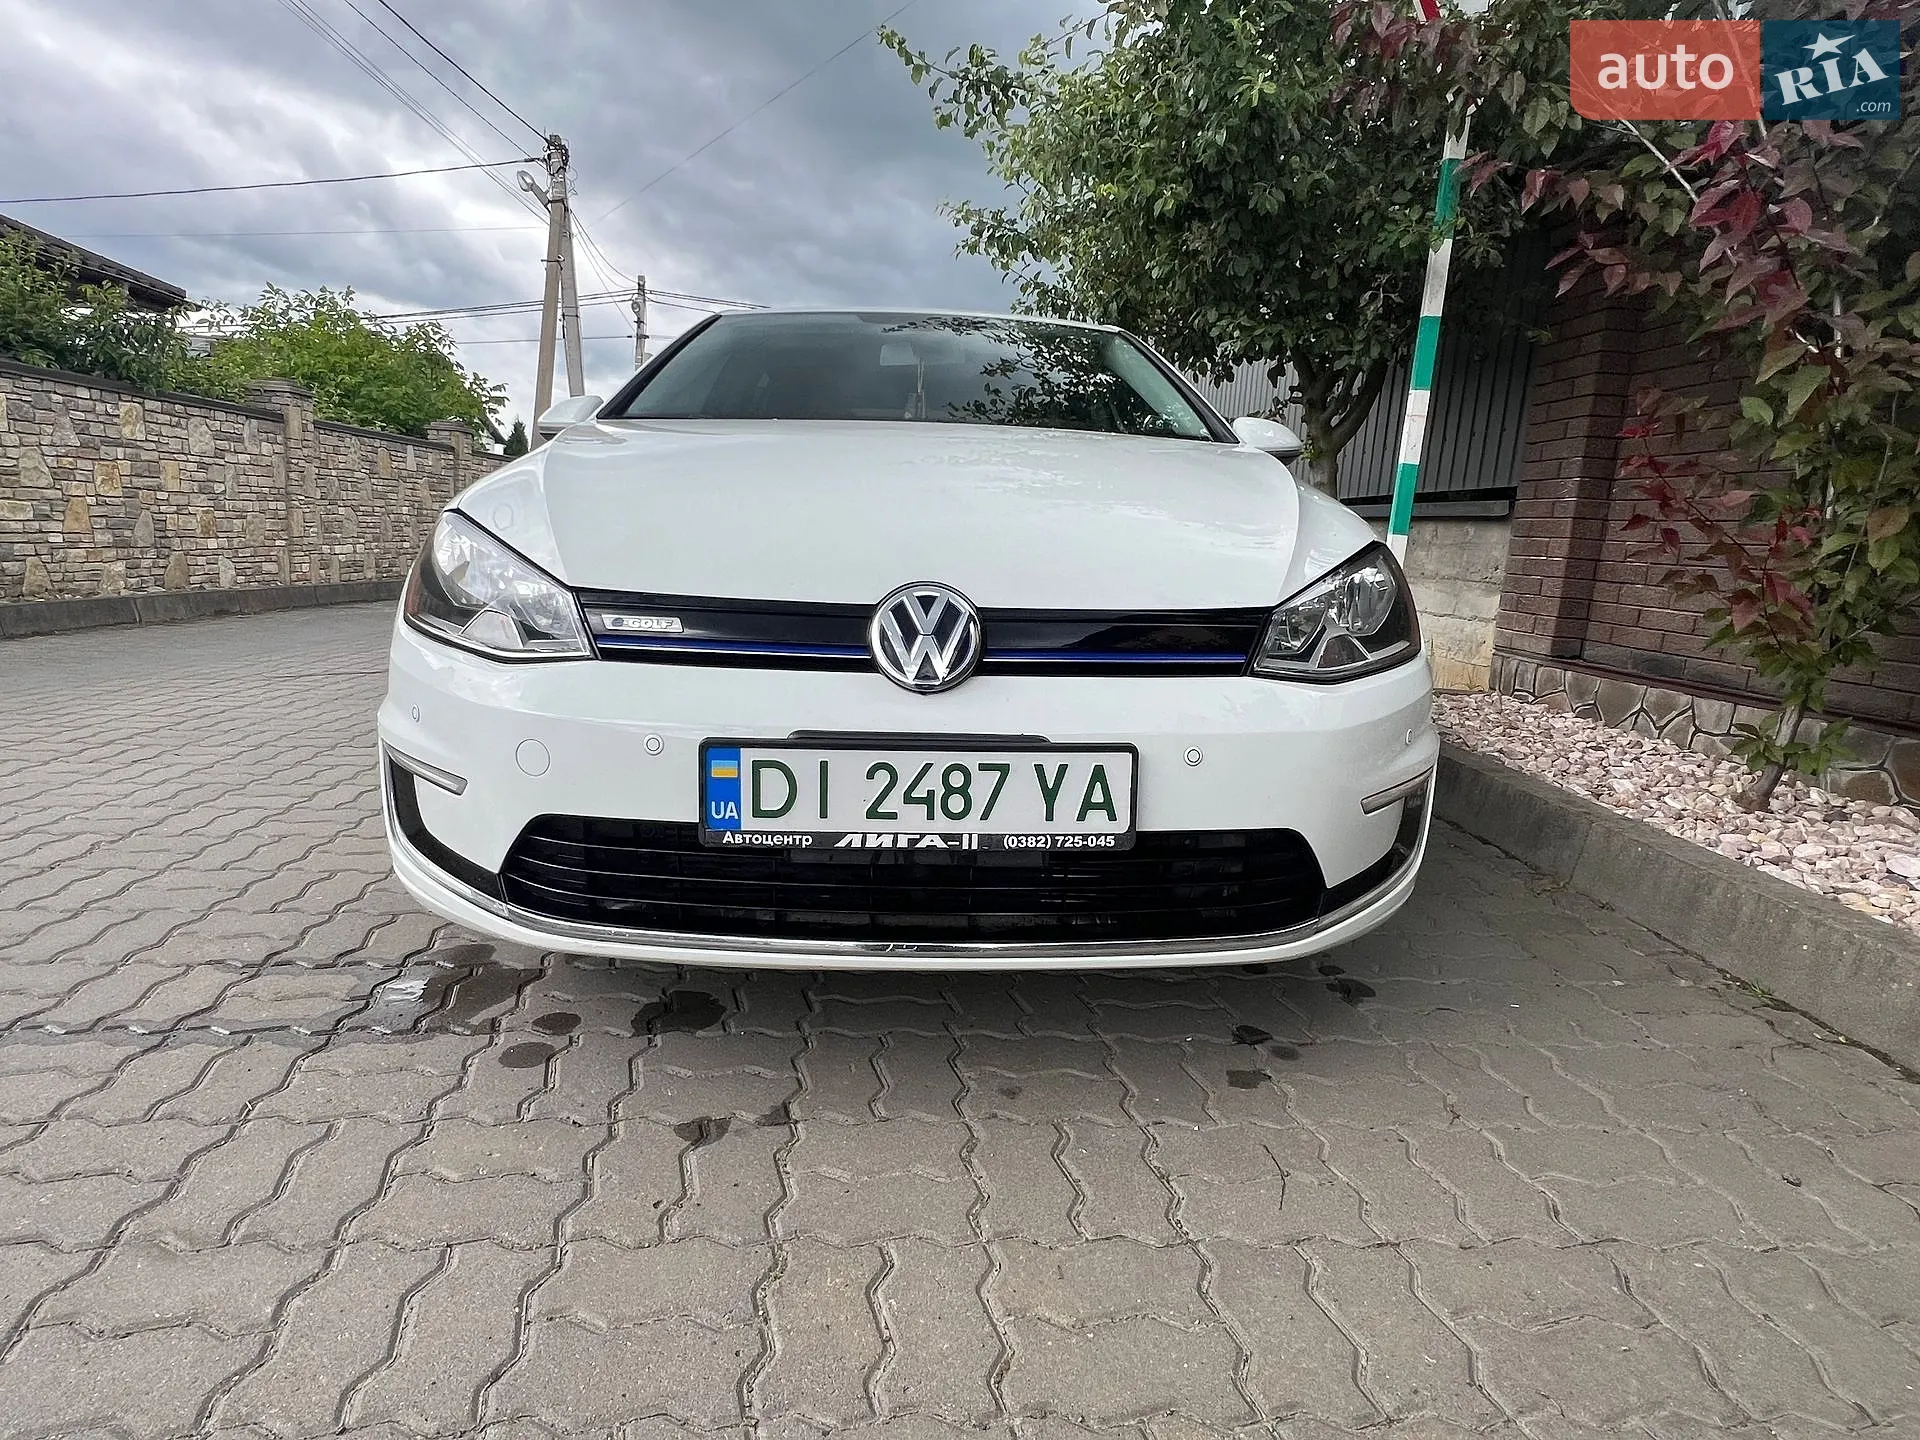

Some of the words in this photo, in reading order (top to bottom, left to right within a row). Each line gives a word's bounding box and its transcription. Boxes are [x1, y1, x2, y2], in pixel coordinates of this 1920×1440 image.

[752, 759, 828, 819] DI
[865, 762, 1011, 821] 2487
[1033, 764, 1118, 822] YA
[711, 801, 739, 820] UA
[722, 831, 813, 848] Автоцентр
[1003, 834, 1051, 849] (0382)
[1055, 835, 1115, 848] 725-045
